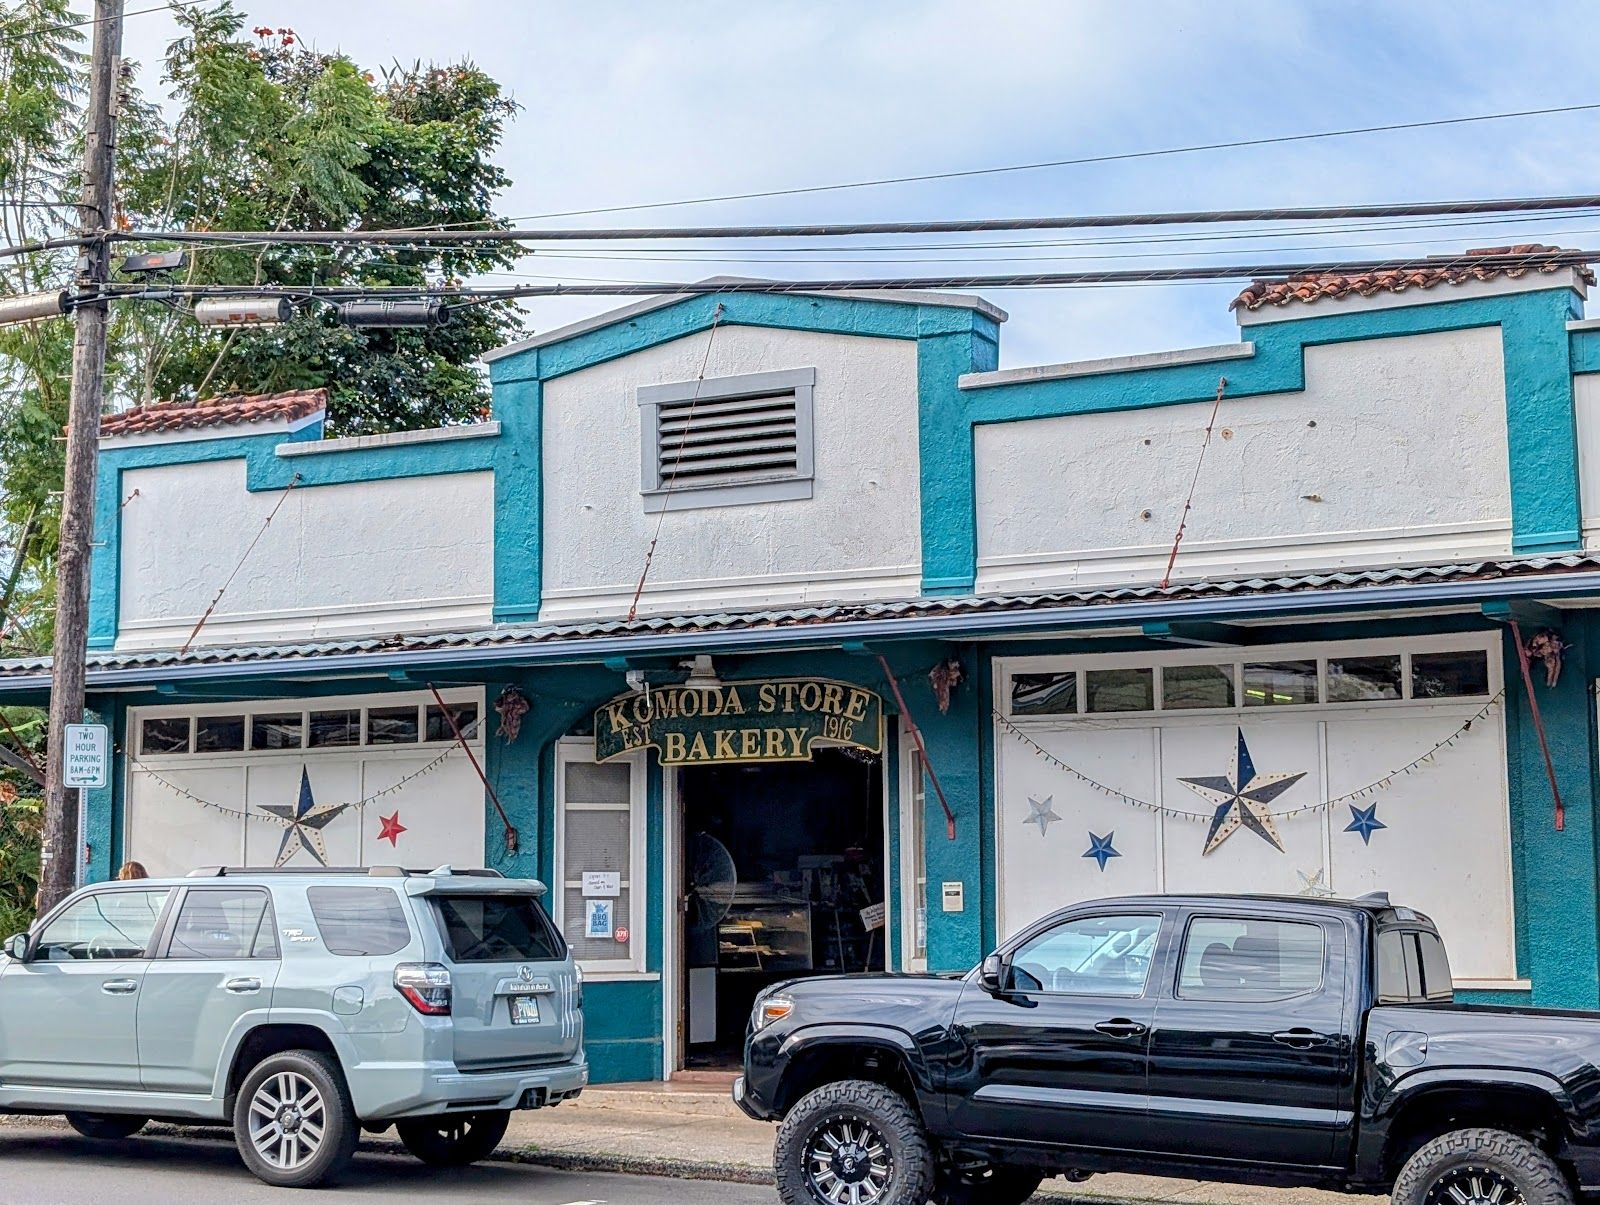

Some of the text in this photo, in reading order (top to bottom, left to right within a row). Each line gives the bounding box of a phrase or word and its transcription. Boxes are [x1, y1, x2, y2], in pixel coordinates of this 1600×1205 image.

[605, 682, 870, 734] KOMODA STORE
[78, 731, 94, 740] TWO
[621, 714, 853, 750] EST 1916
[75, 743, 97, 752] HOUR
[664, 727, 810, 762] BAKERY
[70, 754, 101, 763] PARKING
[70, 765, 101, 774] 8AM-6PM
